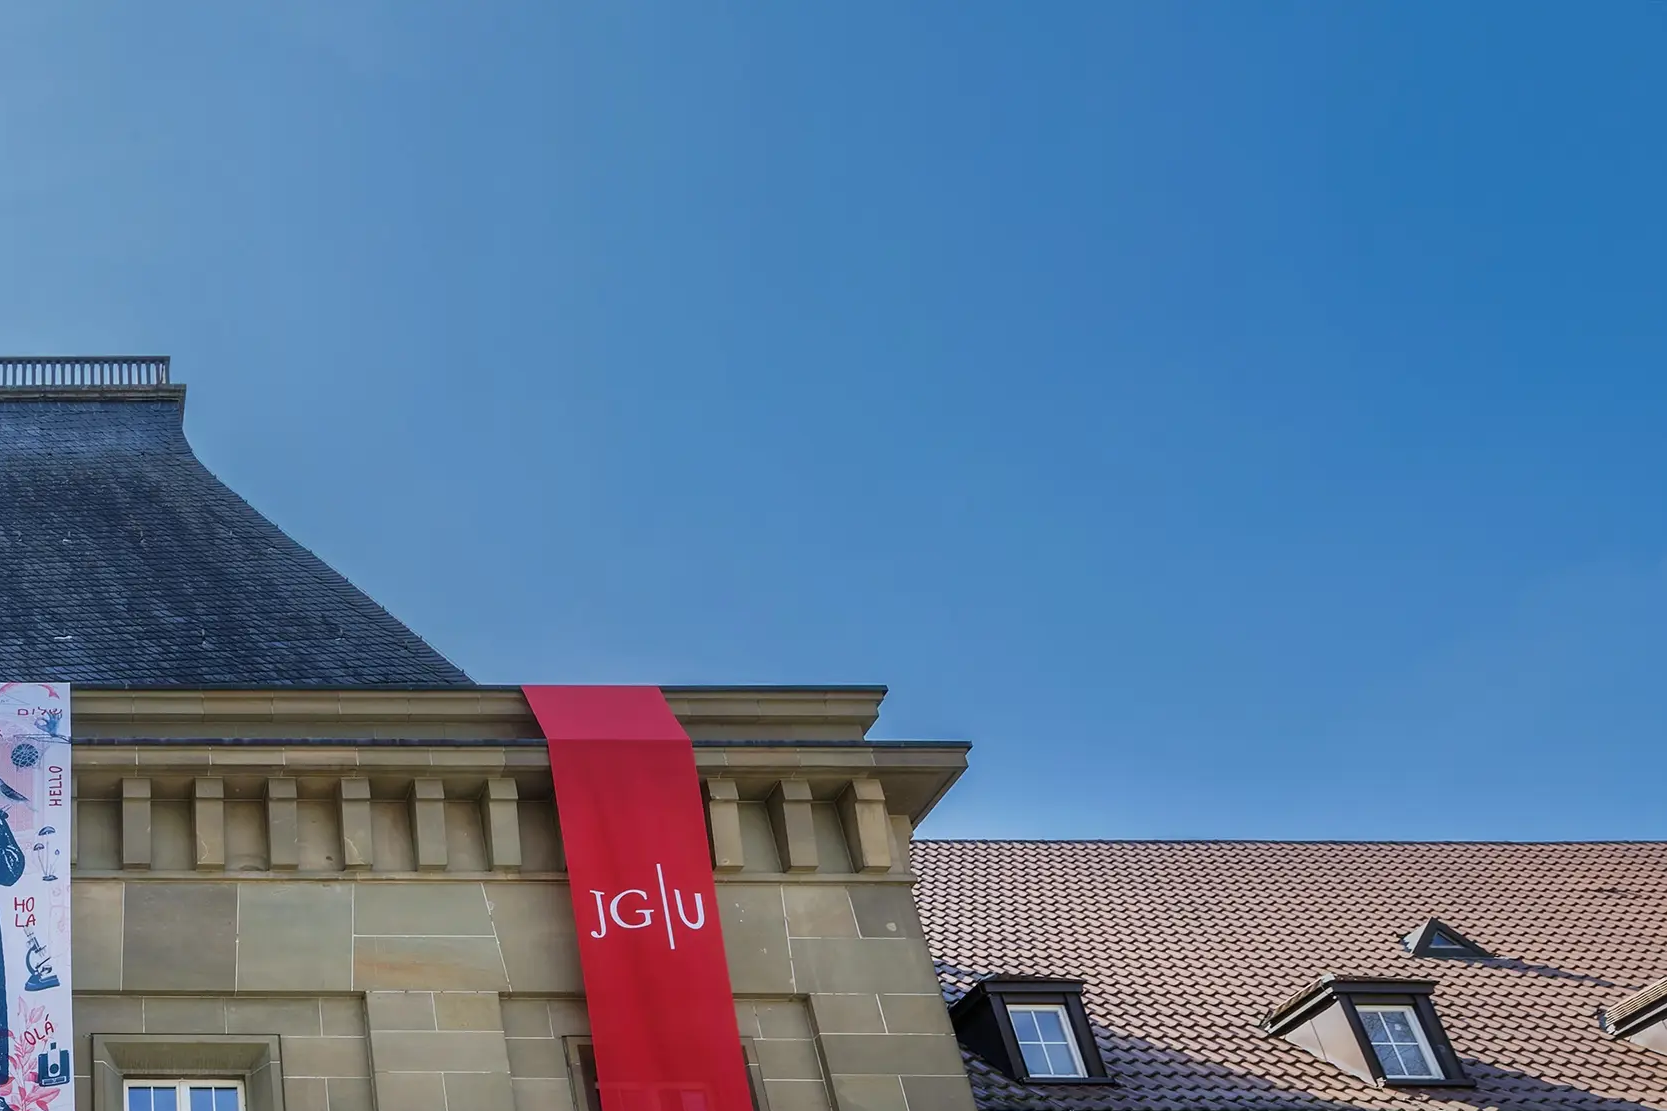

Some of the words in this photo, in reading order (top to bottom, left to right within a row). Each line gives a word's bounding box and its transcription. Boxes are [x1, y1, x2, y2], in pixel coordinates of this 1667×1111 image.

[17, 706, 63, 716] שלום
[49, 765, 63, 807] HELLO
[24, 1013, 54, 1045] OLÁ
